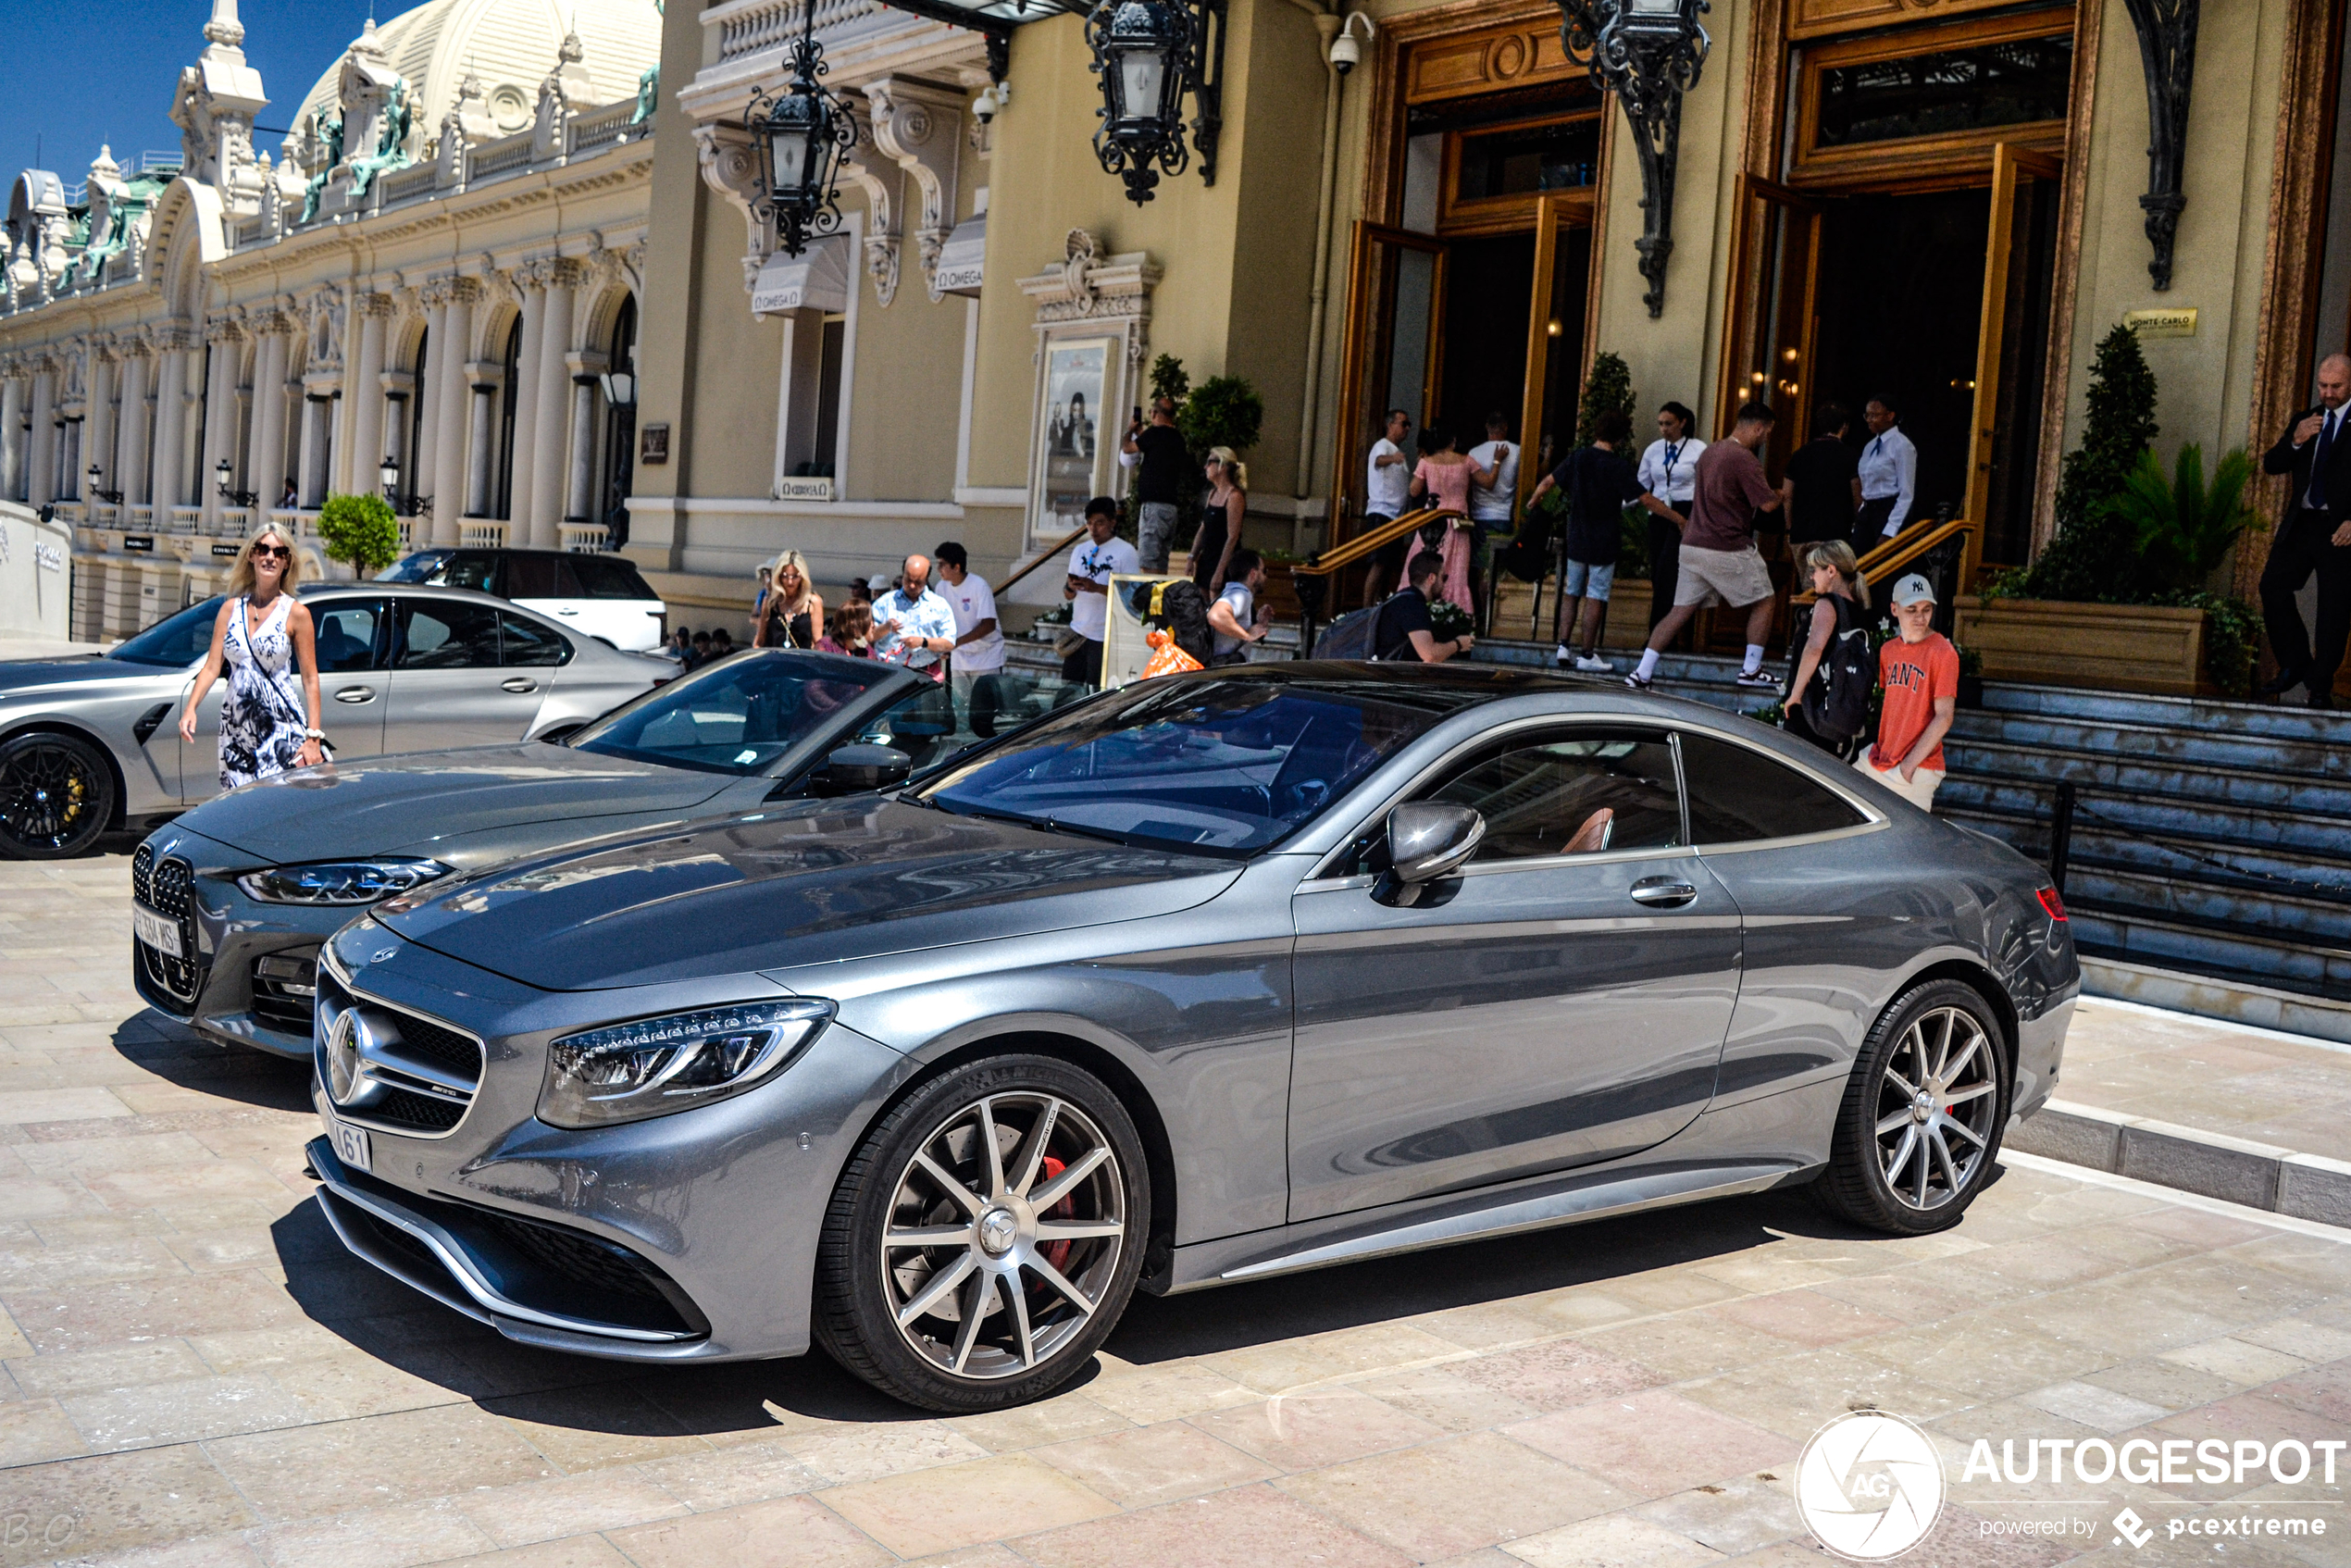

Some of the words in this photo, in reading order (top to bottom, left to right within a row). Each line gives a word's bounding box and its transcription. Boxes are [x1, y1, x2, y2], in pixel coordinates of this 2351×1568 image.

[763, 295, 789, 308] OMEGA
[1887, 661, 1925, 692] ANT
[1041, 1110, 1056, 1146] AMG
[926, 1381, 1006, 1403] MICHELIN
